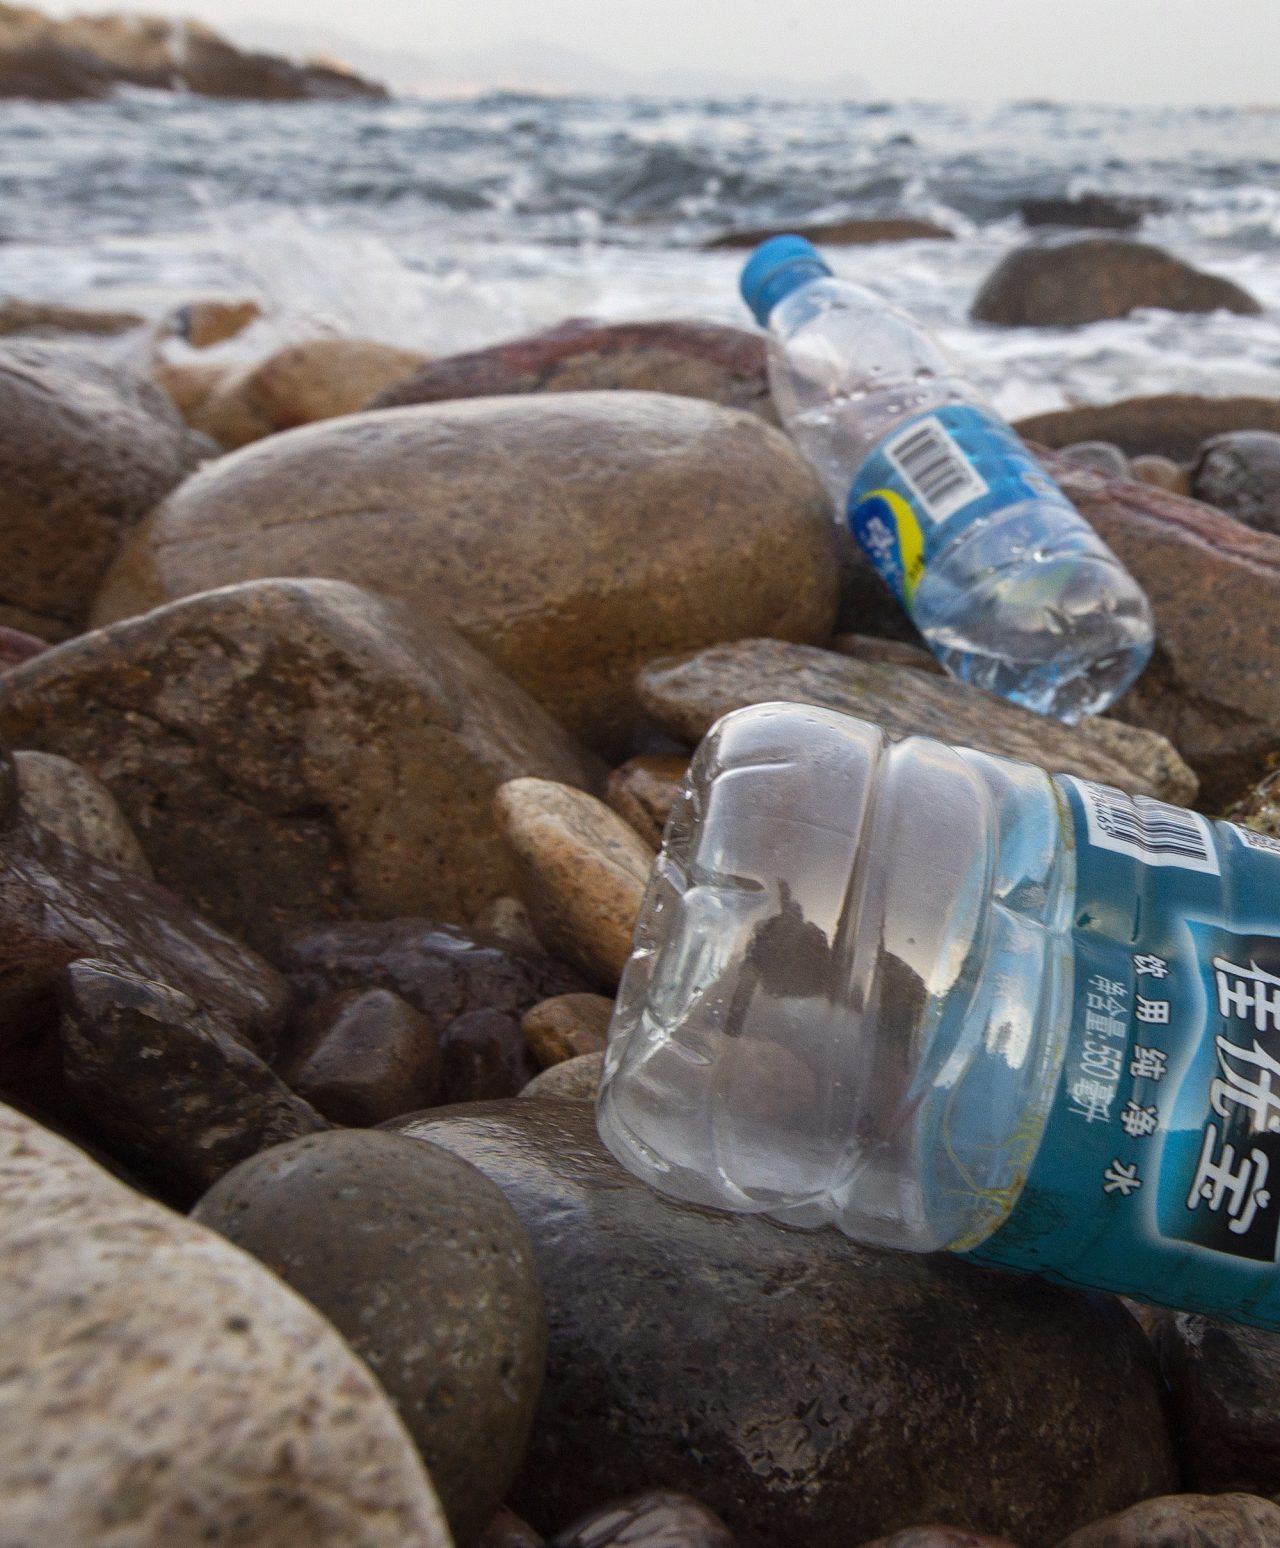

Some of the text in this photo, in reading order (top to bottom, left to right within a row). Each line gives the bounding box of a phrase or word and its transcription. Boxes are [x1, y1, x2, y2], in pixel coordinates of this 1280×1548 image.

[1103, 953, 1171, 1197] 饮用纯净水
